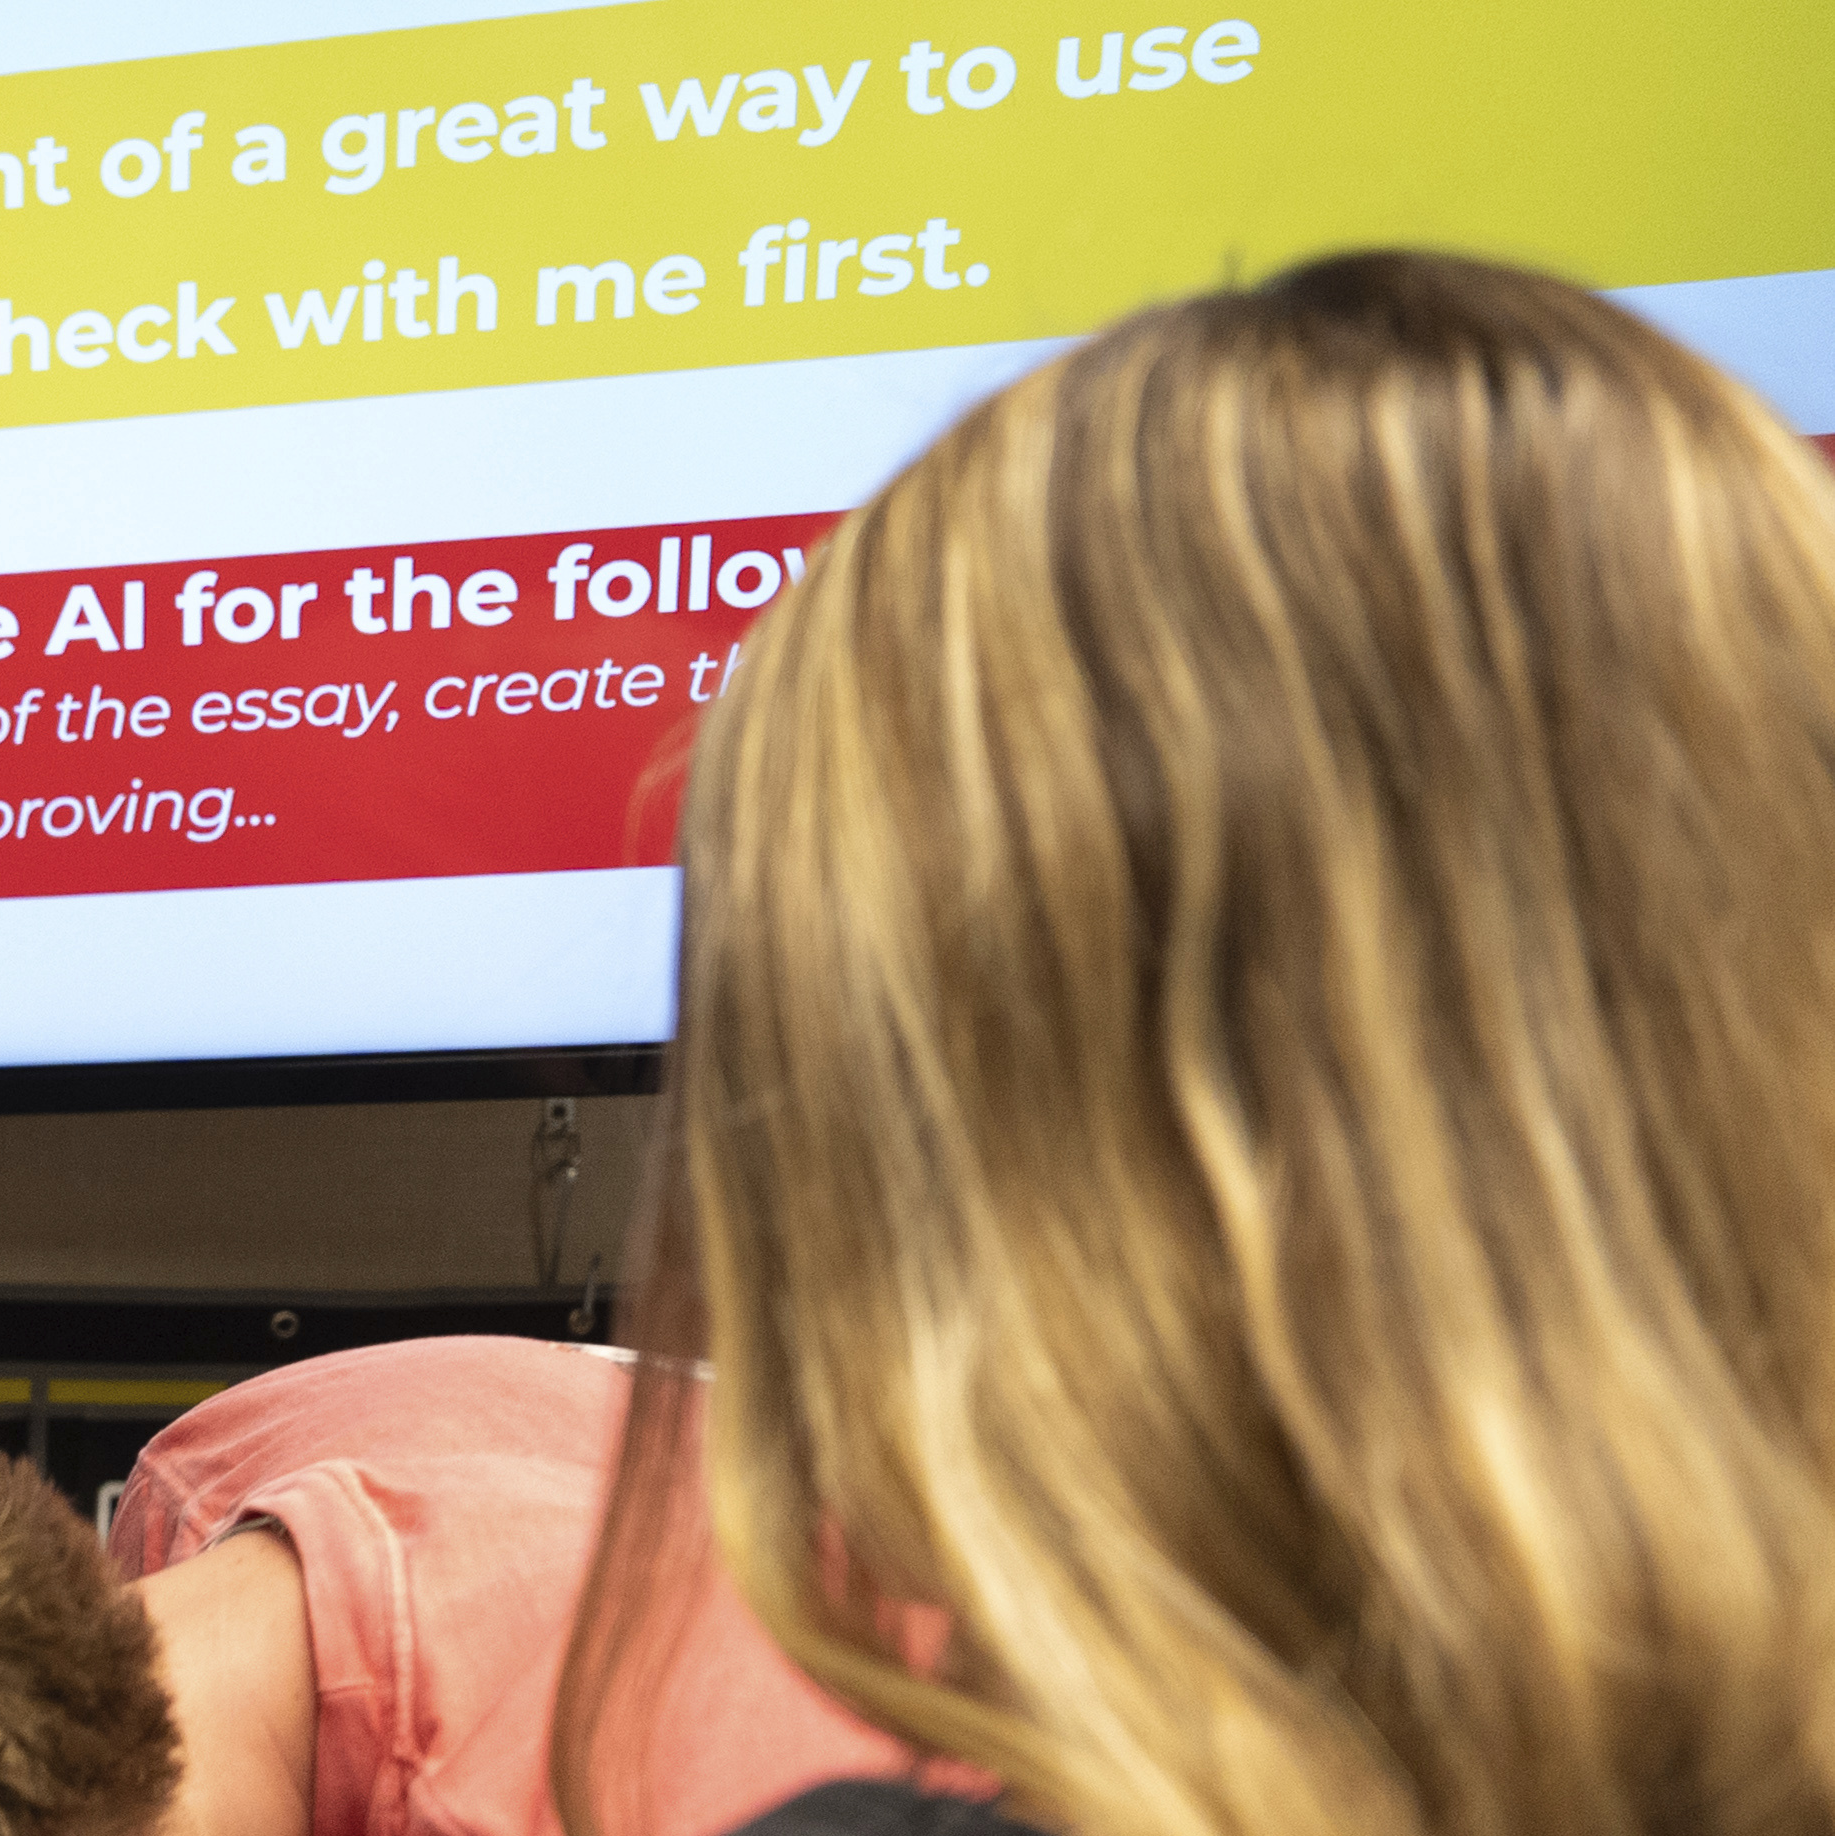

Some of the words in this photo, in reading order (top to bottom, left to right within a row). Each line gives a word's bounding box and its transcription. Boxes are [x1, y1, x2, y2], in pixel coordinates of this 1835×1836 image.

[100, 110, 206, 198] of
[232, 124, 287, 186] a
[322, 78, 607, 195] great
[639, 60, 871, 147] way
[900, 40, 1017, 115] to
[1056, 18, 1260, 99] use
[264, 256, 498, 349] with
[536, 254, 706, 326] me
[738, 218, 991, 308] first.
[45, 581, 145, 655] AI
[175, 571, 317, 646] for
[344, 557, 518, 634] the
[56, 685, 170, 742] the
[192, 681, 399, 738] essay,
[425, 659, 664, 719] create
